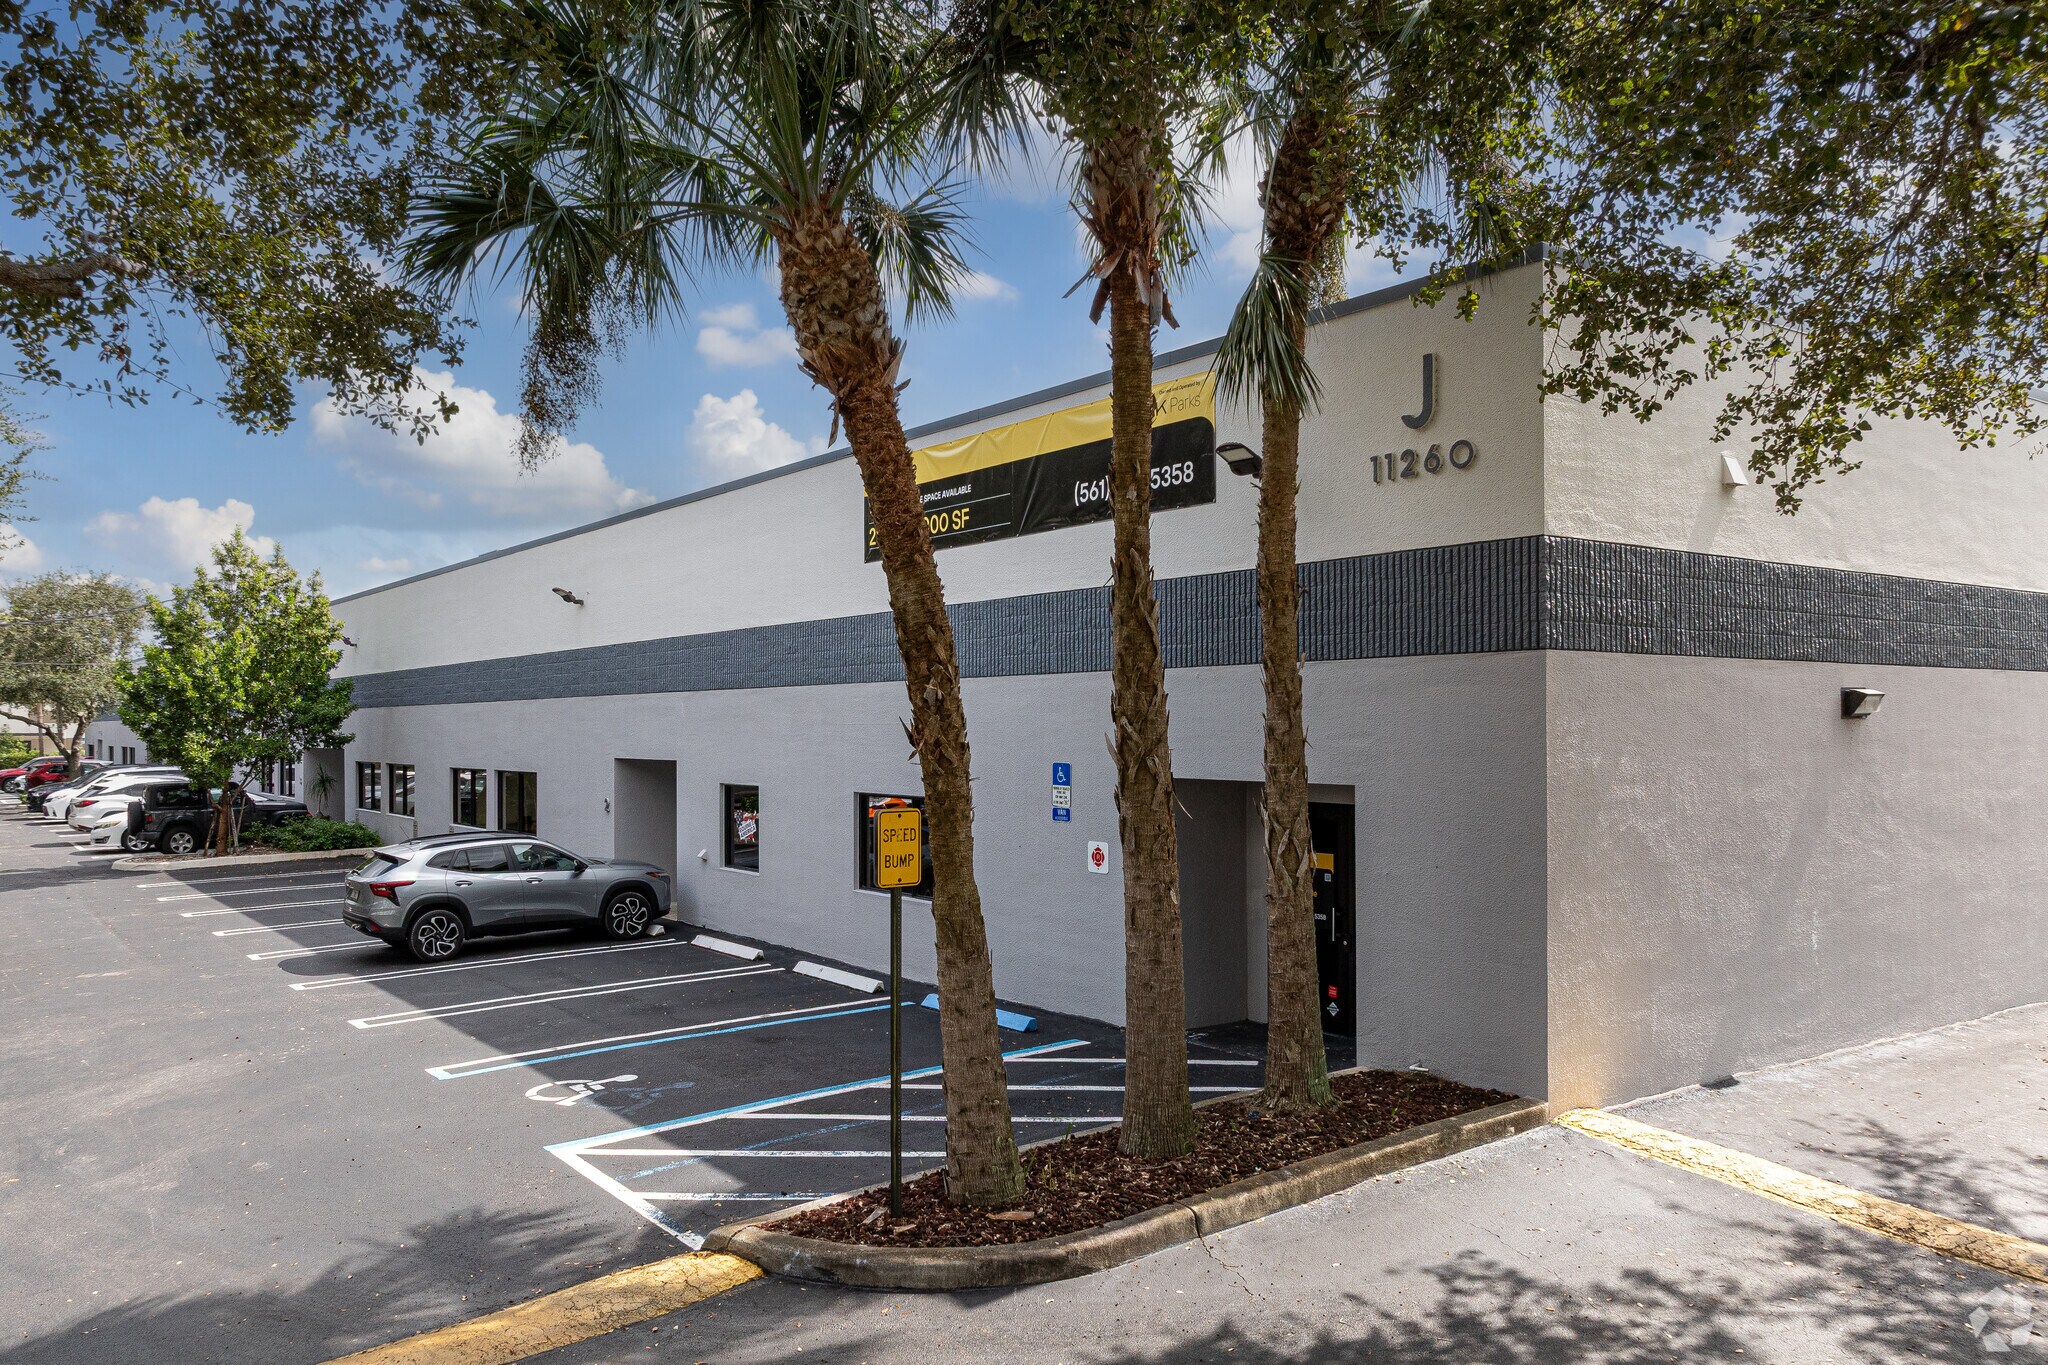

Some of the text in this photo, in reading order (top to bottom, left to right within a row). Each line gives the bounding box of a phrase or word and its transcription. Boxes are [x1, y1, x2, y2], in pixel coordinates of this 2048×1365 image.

[1400, 352, 1437, 430] J
[1169, 394, 1201, 413] Parks
[1369, 438, 1475, 484] 11260
[923, 489, 942, 504] SPACE
[941, 484, 972, 502] AVAILABLE
[951, 507, 970, 531] SF
[882, 827, 917, 843] SPEED
[884, 853, 915, 869] BUMP
